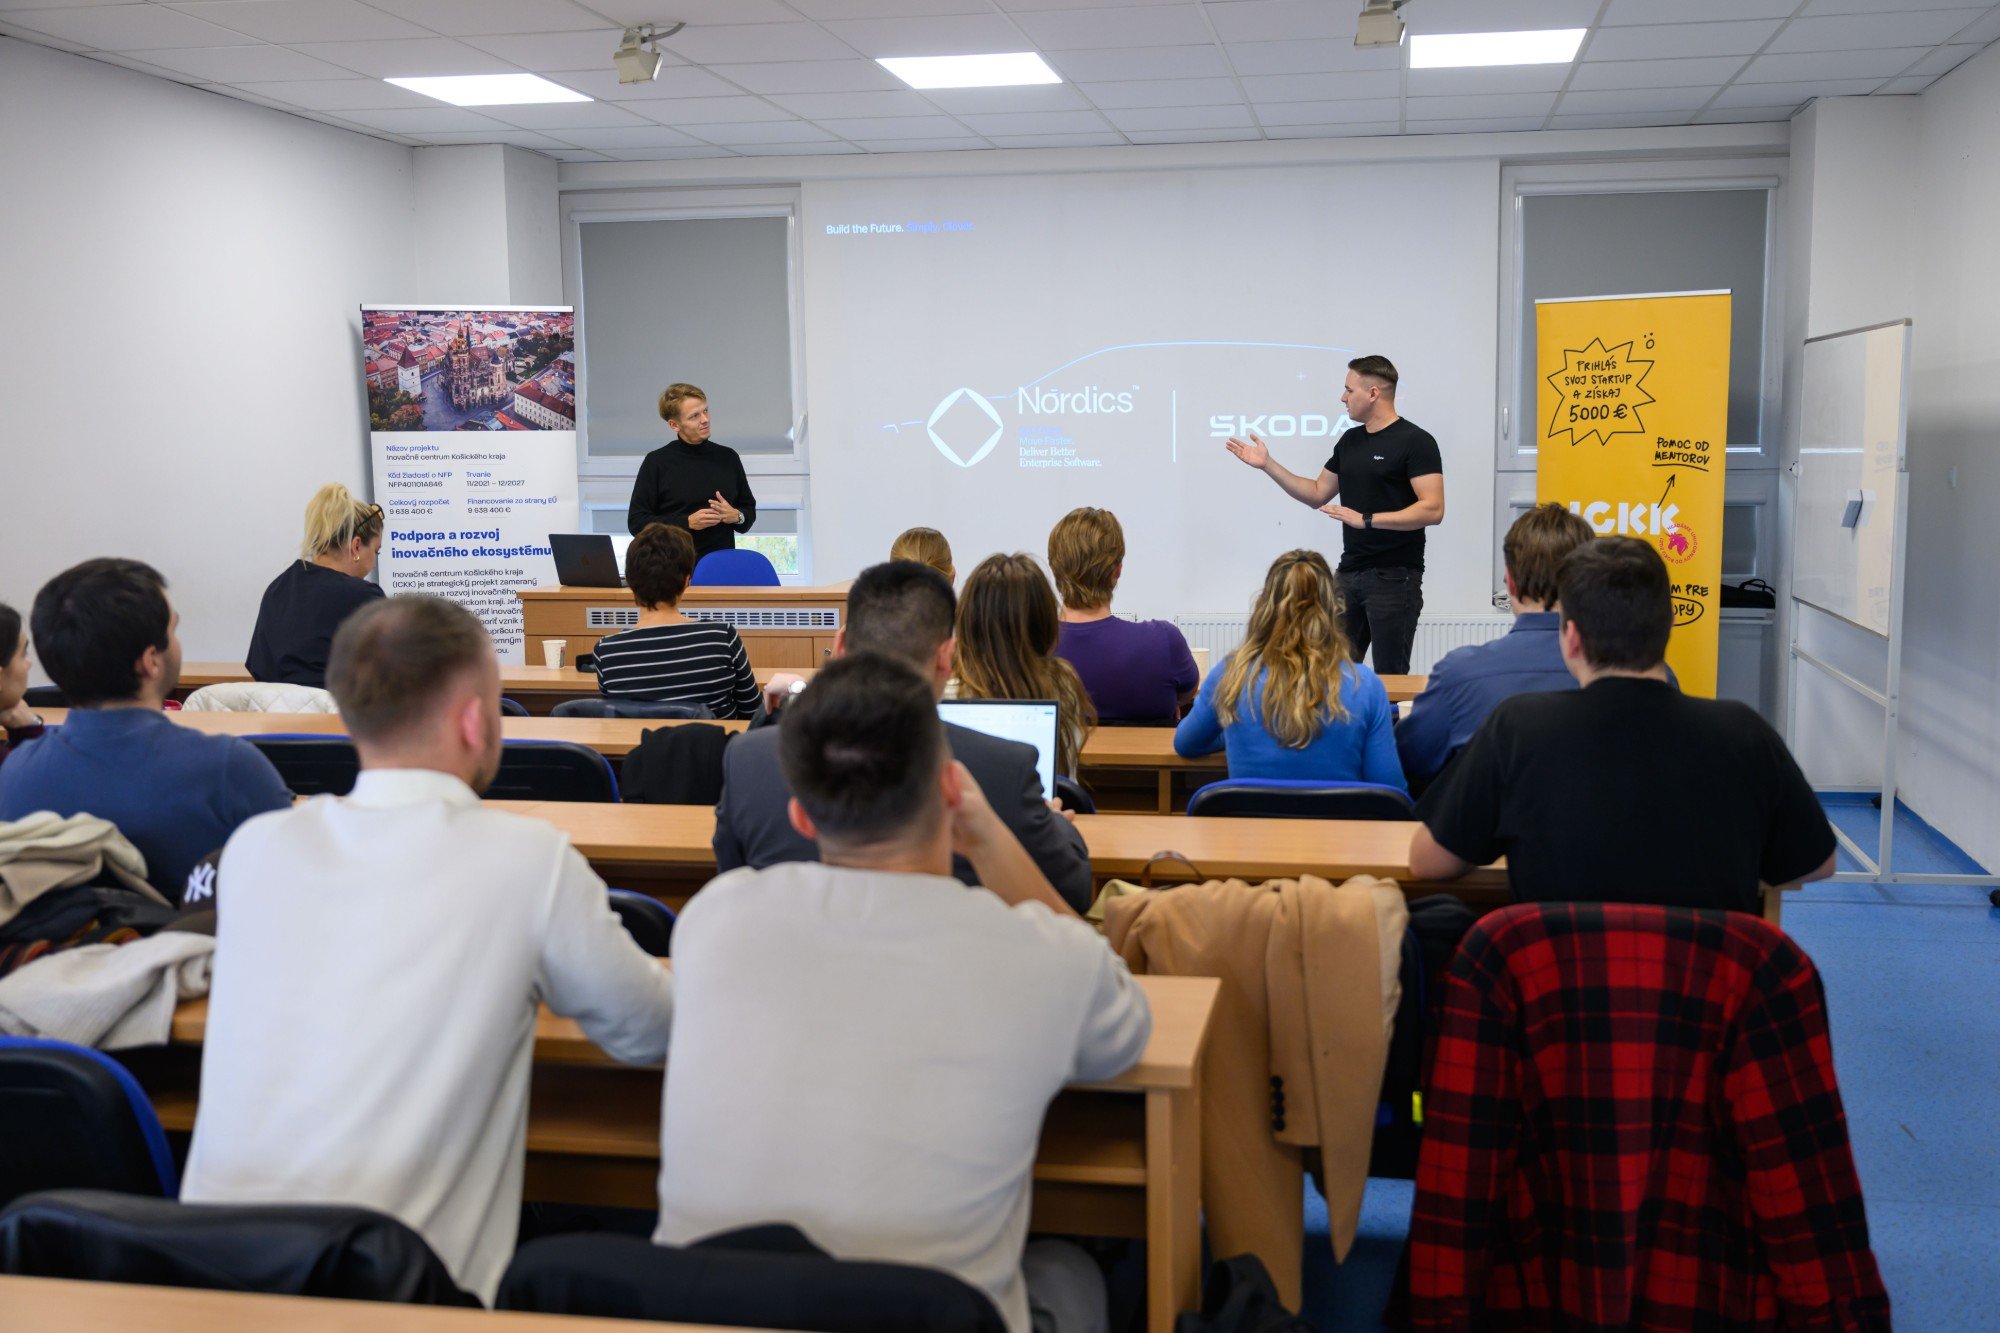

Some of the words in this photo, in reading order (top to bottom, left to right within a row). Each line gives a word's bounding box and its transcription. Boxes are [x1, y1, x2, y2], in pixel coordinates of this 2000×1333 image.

[826, 223, 850, 235] Build
[852, 223, 869, 234] the
[870, 223, 904, 233] Future.
[1576, 354, 1617, 372] PRIHLÁS
[1564, 375, 1587, 386] SVOJ
[1591, 374, 1632, 385] STARTUP
[1572, 389, 1582, 400] A
[1584, 385, 1621, 400] ZÍSKAJ
[1569, 404, 1610, 423] 5000
[1613, 403, 1628, 419] €
[409, 444, 440, 453] projektu
[1656, 436, 1692, 450] POMOC
[1695, 440, 1710, 452] OD
[488, 453, 506, 461] kraja
[1019, 446, 1049, 457] Deliver
[1050, 446, 1077, 457] Better
[1654, 450, 1710, 465] MENTOROV
[1019, 457, 1062, 469] Enterprise
[391, 530, 446, 543] Podpora
[448, 531, 457, 540] a
[460, 529, 500, 541] rozvoj
[391, 547, 469, 559] inovačného
[472, 544, 552, 559] ekosystému
[430, 569, 463, 577] centrum
[505, 568, 524, 577] kraja
[392, 580, 417, 588] (ICKK)
[417, 580, 425, 588] je
[471, 578, 498, 587] projekt
[447, 589, 470, 597] rozvoj
[1685, 584, 1709, 597] PRE
